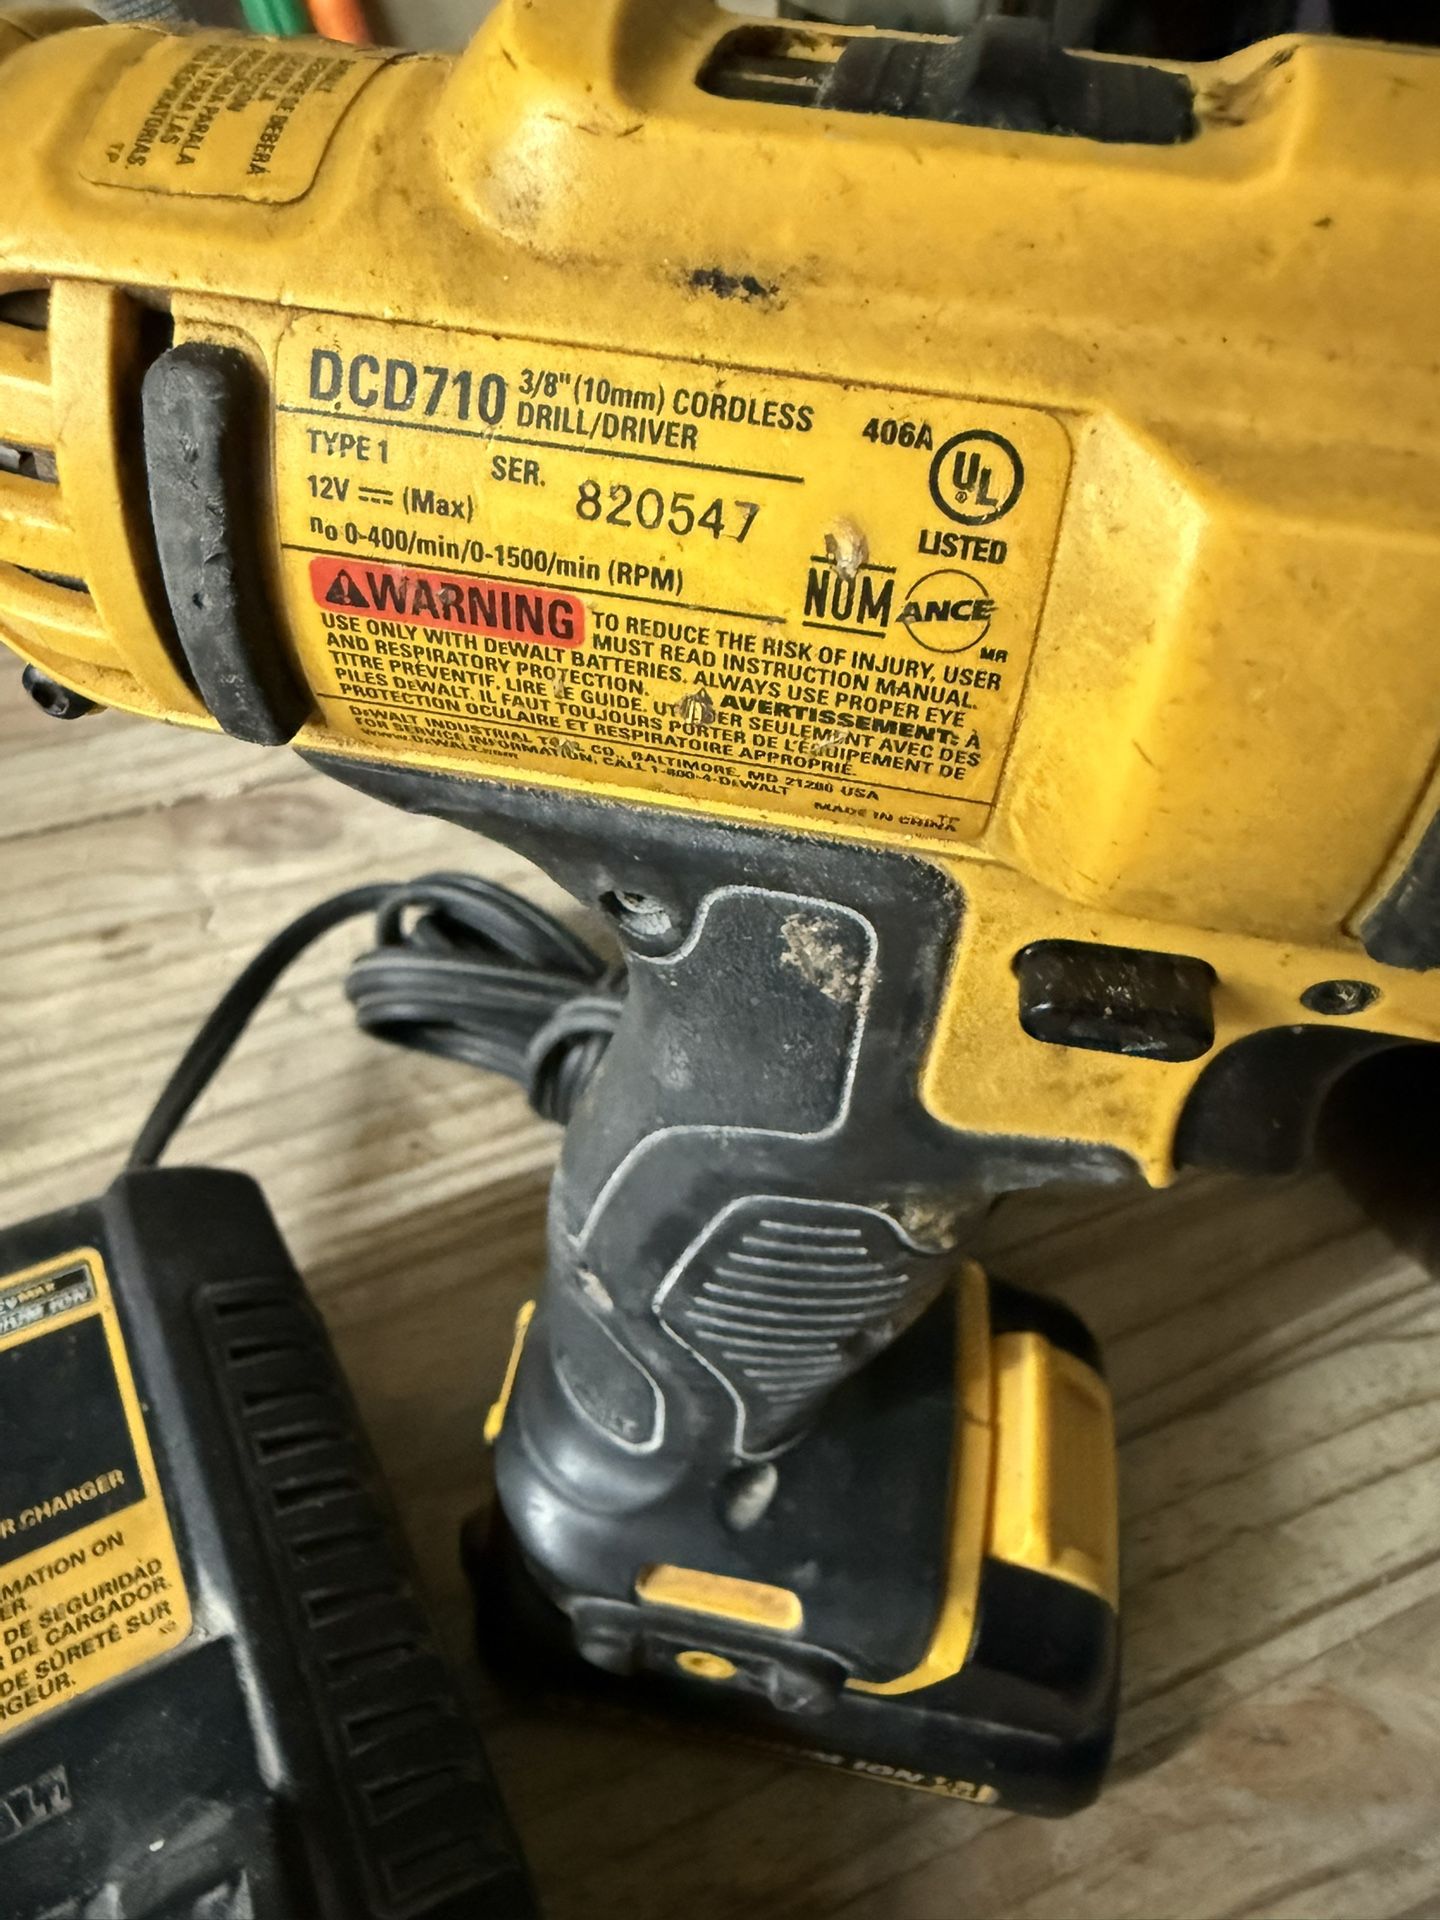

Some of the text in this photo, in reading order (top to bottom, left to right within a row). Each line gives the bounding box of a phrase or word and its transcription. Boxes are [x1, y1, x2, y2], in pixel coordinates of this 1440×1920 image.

[309, 348, 507, 425] DCD710
[519, 368, 815, 433] 3/8" (10mm) CORDLESS
[307, 428, 388, 464] TYPE 1
[517, 401, 699, 451] DRILL/DRIVER
[862, 418, 933, 451] 406A
[308, 475, 474, 524] 12V (Max)
[491, 454, 760, 543] SER. 820547
[345, 522, 600, 581] 0-400/min/0-1500/min
[608, 559, 684, 596] (RPM)
[918, 529, 1008, 565] LISTED
[366, 571, 574, 639] WARNING
[803, 567, 895, 627] NOM
[895, 599, 999, 624] ANCE
[320, 612, 361, 633] USE
[366, 619, 418, 641] ONLY
[423, 627, 477, 651] WITH
[571, 651, 688, 684] BATTERIES.
[693, 670, 781, 699] ALWAYS
[787, 684, 829, 706] USE
[835, 692, 920, 720] PROPER
[925, 706, 966, 728] EYE
[592, 610, 1002, 691] TO REDUCE THE RISK OF INJURY, USER
[592, 632, 977, 710] MUST READ INSTRUCTION MANUAL.
[326, 632, 369, 652] AND
[374, 639, 510, 674] RESPIRATORY
[517, 661, 650, 697] PROTECTION.
[719, 694, 960, 746] AVERTISSEMENT:
[328, 650, 385, 671] TITRE
[505, 677, 548, 697] LIRE
[580, 690, 647, 713] GUIDE.
[879, 738, 934, 759] AVEC
[939, 748, 982, 767] DES
[335, 667, 388, 687] PILES
[479, 689, 497, 704] IL
[501, 692, 551, 712] FAUT
[555, 701, 662, 731] TOUJOURS
[668, 720, 746, 744] PORTER
[752, 733, 779, 749] DE
[939, 764, 967, 781] DE
[339, 682, 460, 712] PROTECTION
[466, 702, 561, 728] OCULAIRE
[565, 718, 588, 732] ET
[594, 724, 734, 756] RESPIRATOIRE
[354, 717, 390, 731] FOR
[393, 722, 463, 741] SERVICE
[602, 757, 646, 772] CALL
[425, 717, 532, 743] INDUSTRIAL
[748, 770, 779, 783] MD
[840, 785, 879, 800] USA
[18, 1468, 125, 1531] CHARGER
[0, 1530, 125, 1601] MATION ON
[4, 1558, 162, 1646] DE SEGURIDAD
[10, 1575, 173, 1664] DE CARGADOR.
[126, 1600, 172, 1634] SUR
